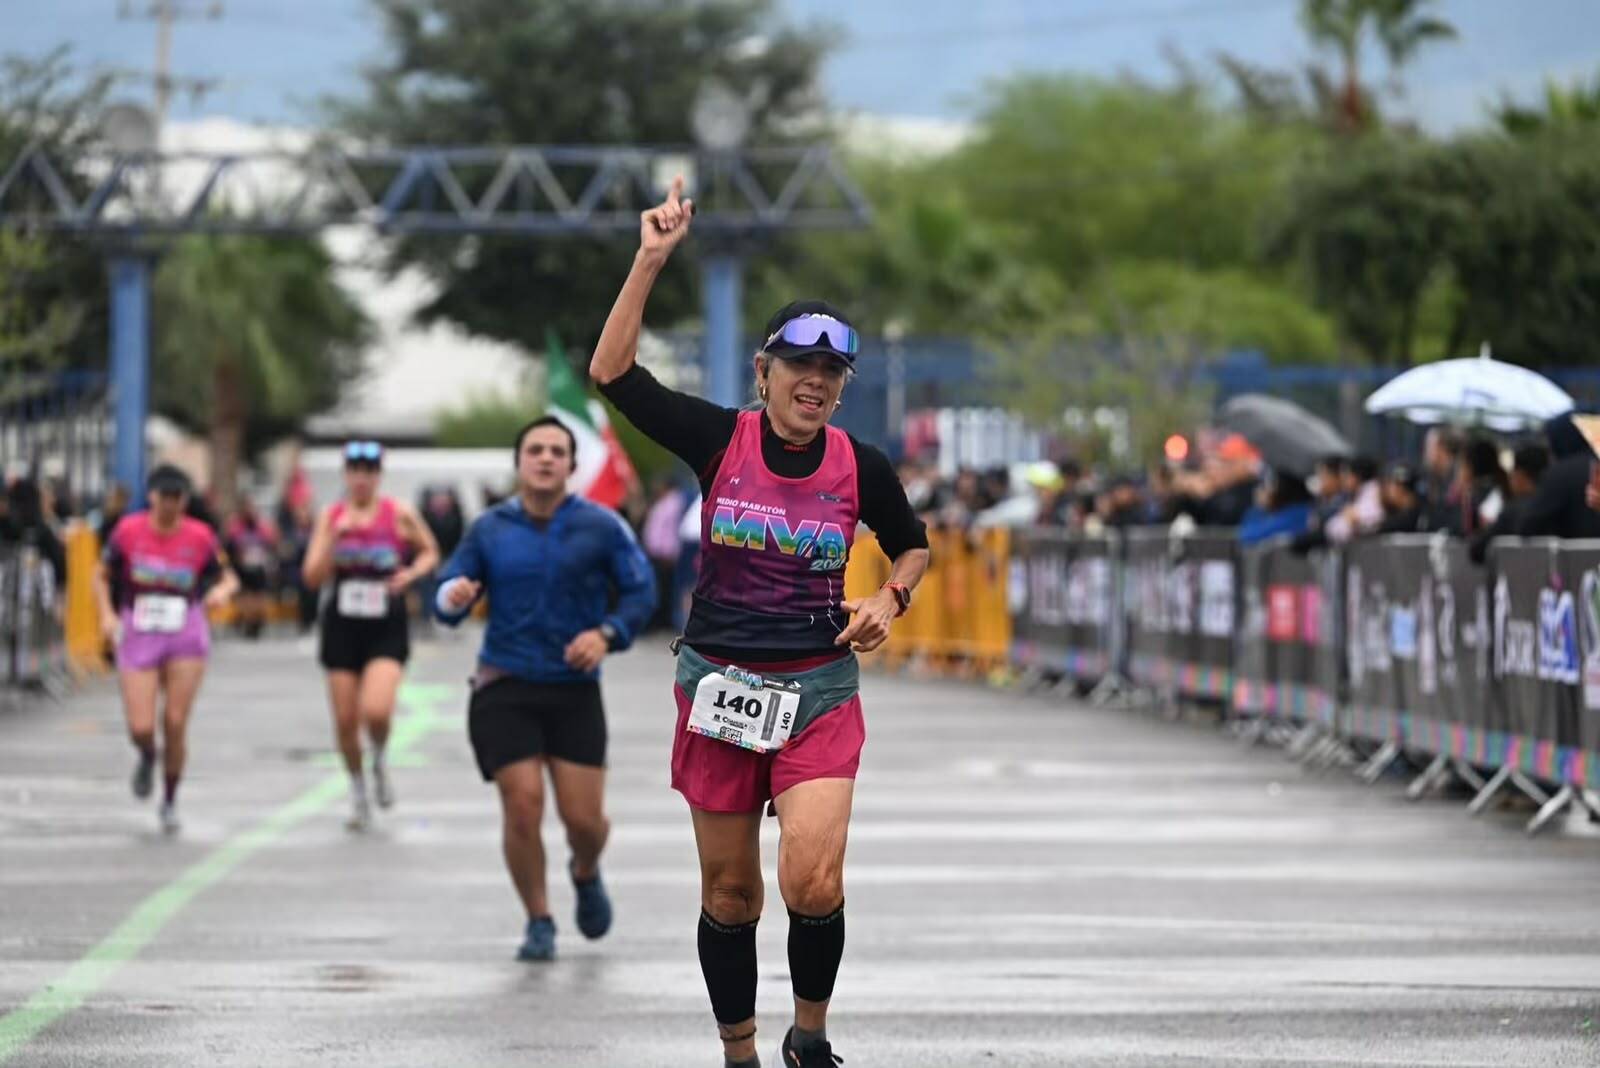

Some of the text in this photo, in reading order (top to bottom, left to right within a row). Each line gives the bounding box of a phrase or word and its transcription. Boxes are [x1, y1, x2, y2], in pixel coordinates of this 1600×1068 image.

[716, 497, 739, 507] MEDIO
[711, 506, 846, 558] MVA
[713, 690, 762, 718] 140
[780, 712, 792, 730] 140
